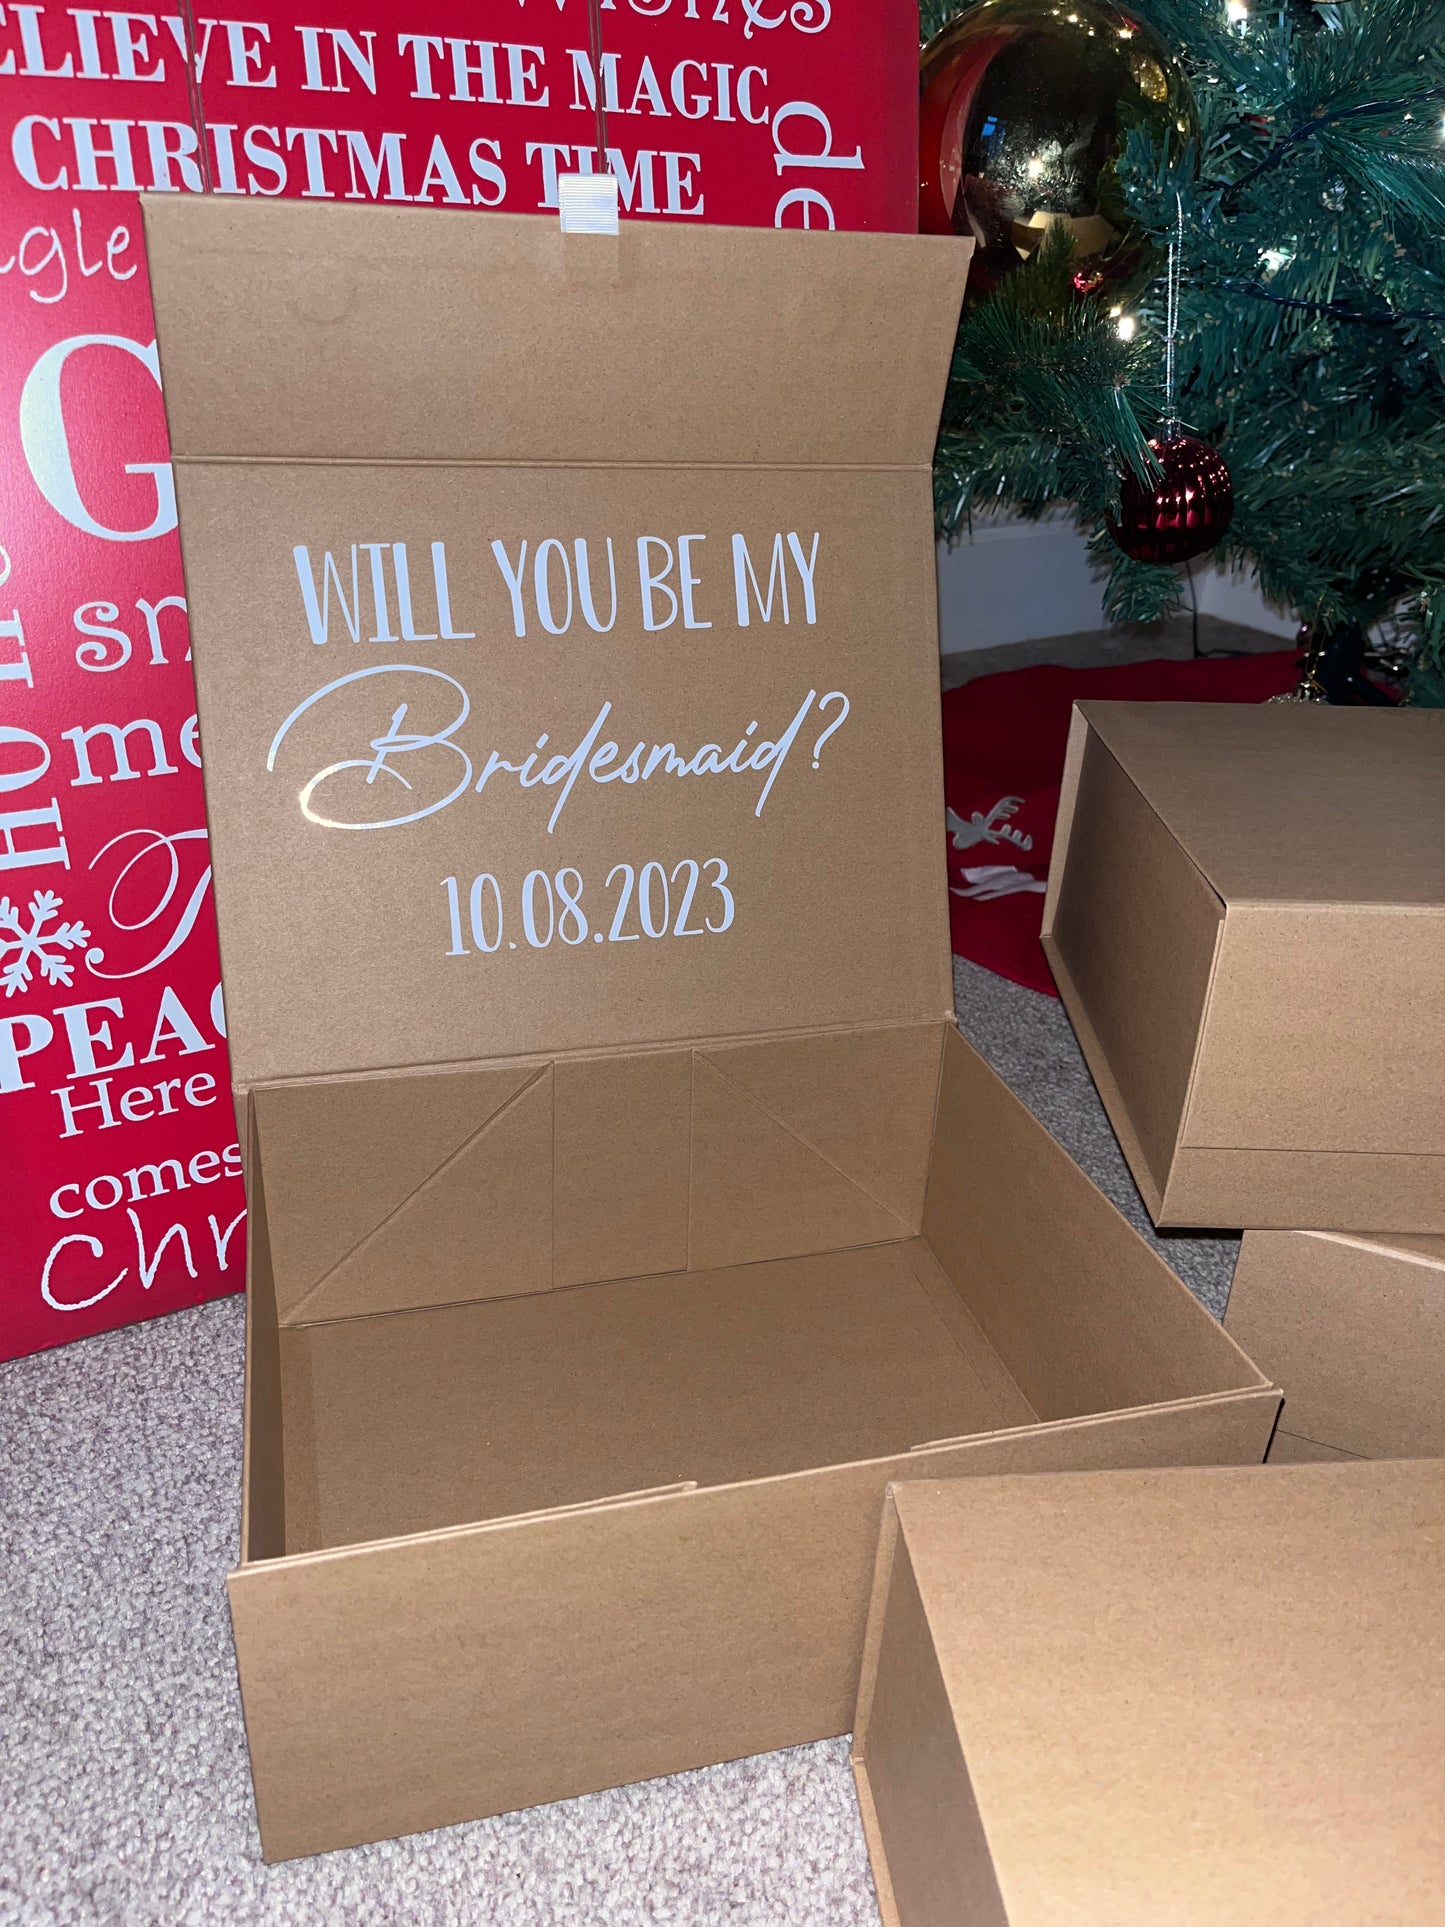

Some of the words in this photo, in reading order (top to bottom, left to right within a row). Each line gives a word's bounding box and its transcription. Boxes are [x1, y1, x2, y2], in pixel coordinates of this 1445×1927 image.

[0, 3, 278, 88] LIEVE
[294, 26, 377, 95] IN
[398, 33, 549, 107] THE
[565, 49, 769, 125] MAGIC
[11, 115, 507, 206] CHRISTMAS
[0, 208, 138, 304] gle
[292, 541, 476, 645] WILL
[491, 537, 618, 637] YOU
[637, 534, 713, 632] BE
[731, 532, 820, 627] MY
[266, 663, 851, 834] Bridesmaid?
[439, 858, 736, 956] 10.08.2023
[51, 1073, 217, 1138] Here
[50, 1143, 243, 1219] comes
